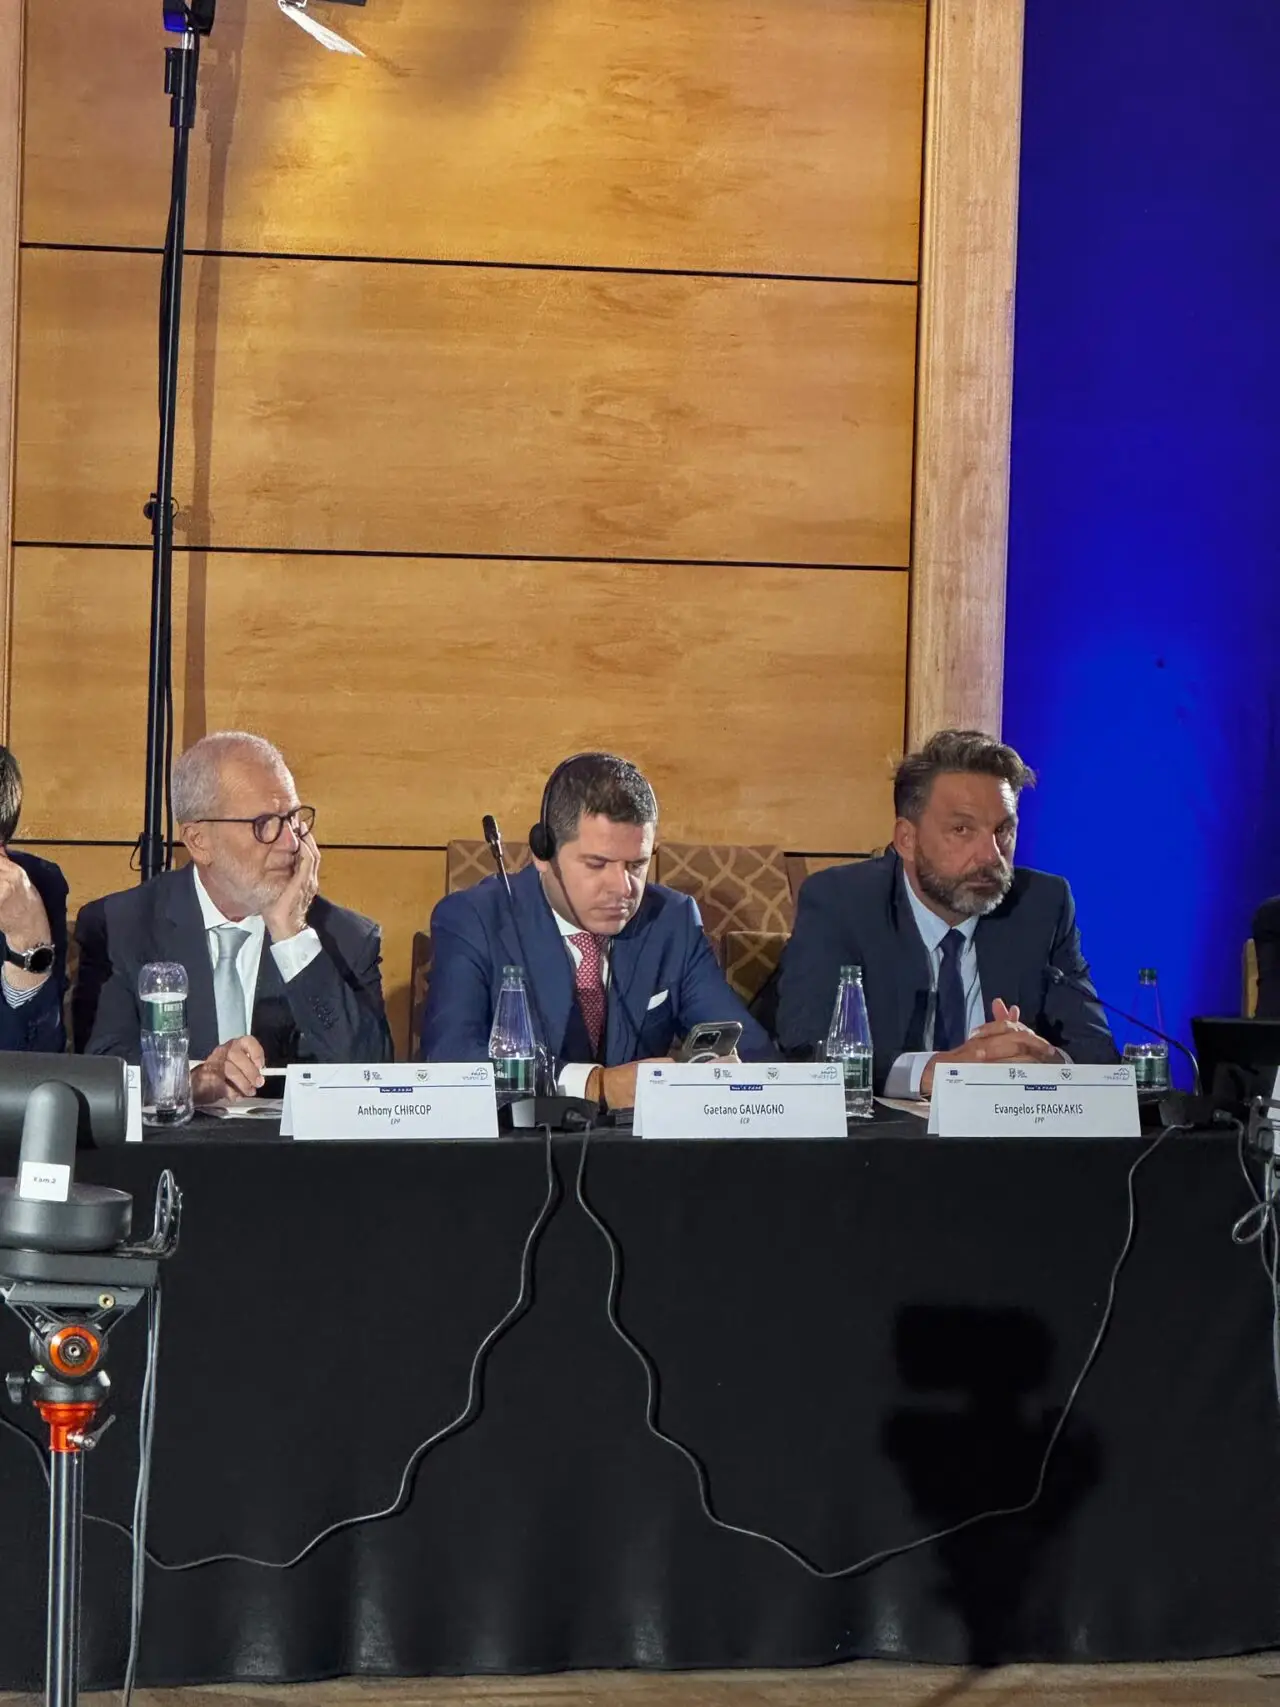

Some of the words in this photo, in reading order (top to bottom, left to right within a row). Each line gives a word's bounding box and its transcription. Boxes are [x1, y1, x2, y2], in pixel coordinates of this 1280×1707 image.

[357, 1104, 393, 1117] Anthony
[394, 1104, 432, 1116] CHIRCOP
[703, 1104, 738, 1115] Gaetano
[739, 1103, 785, 1115] GALVAGNO
[994, 1103, 1035, 1116] Evangelos
[1036, 1103, 1083, 1114] FRAGKAKIS
